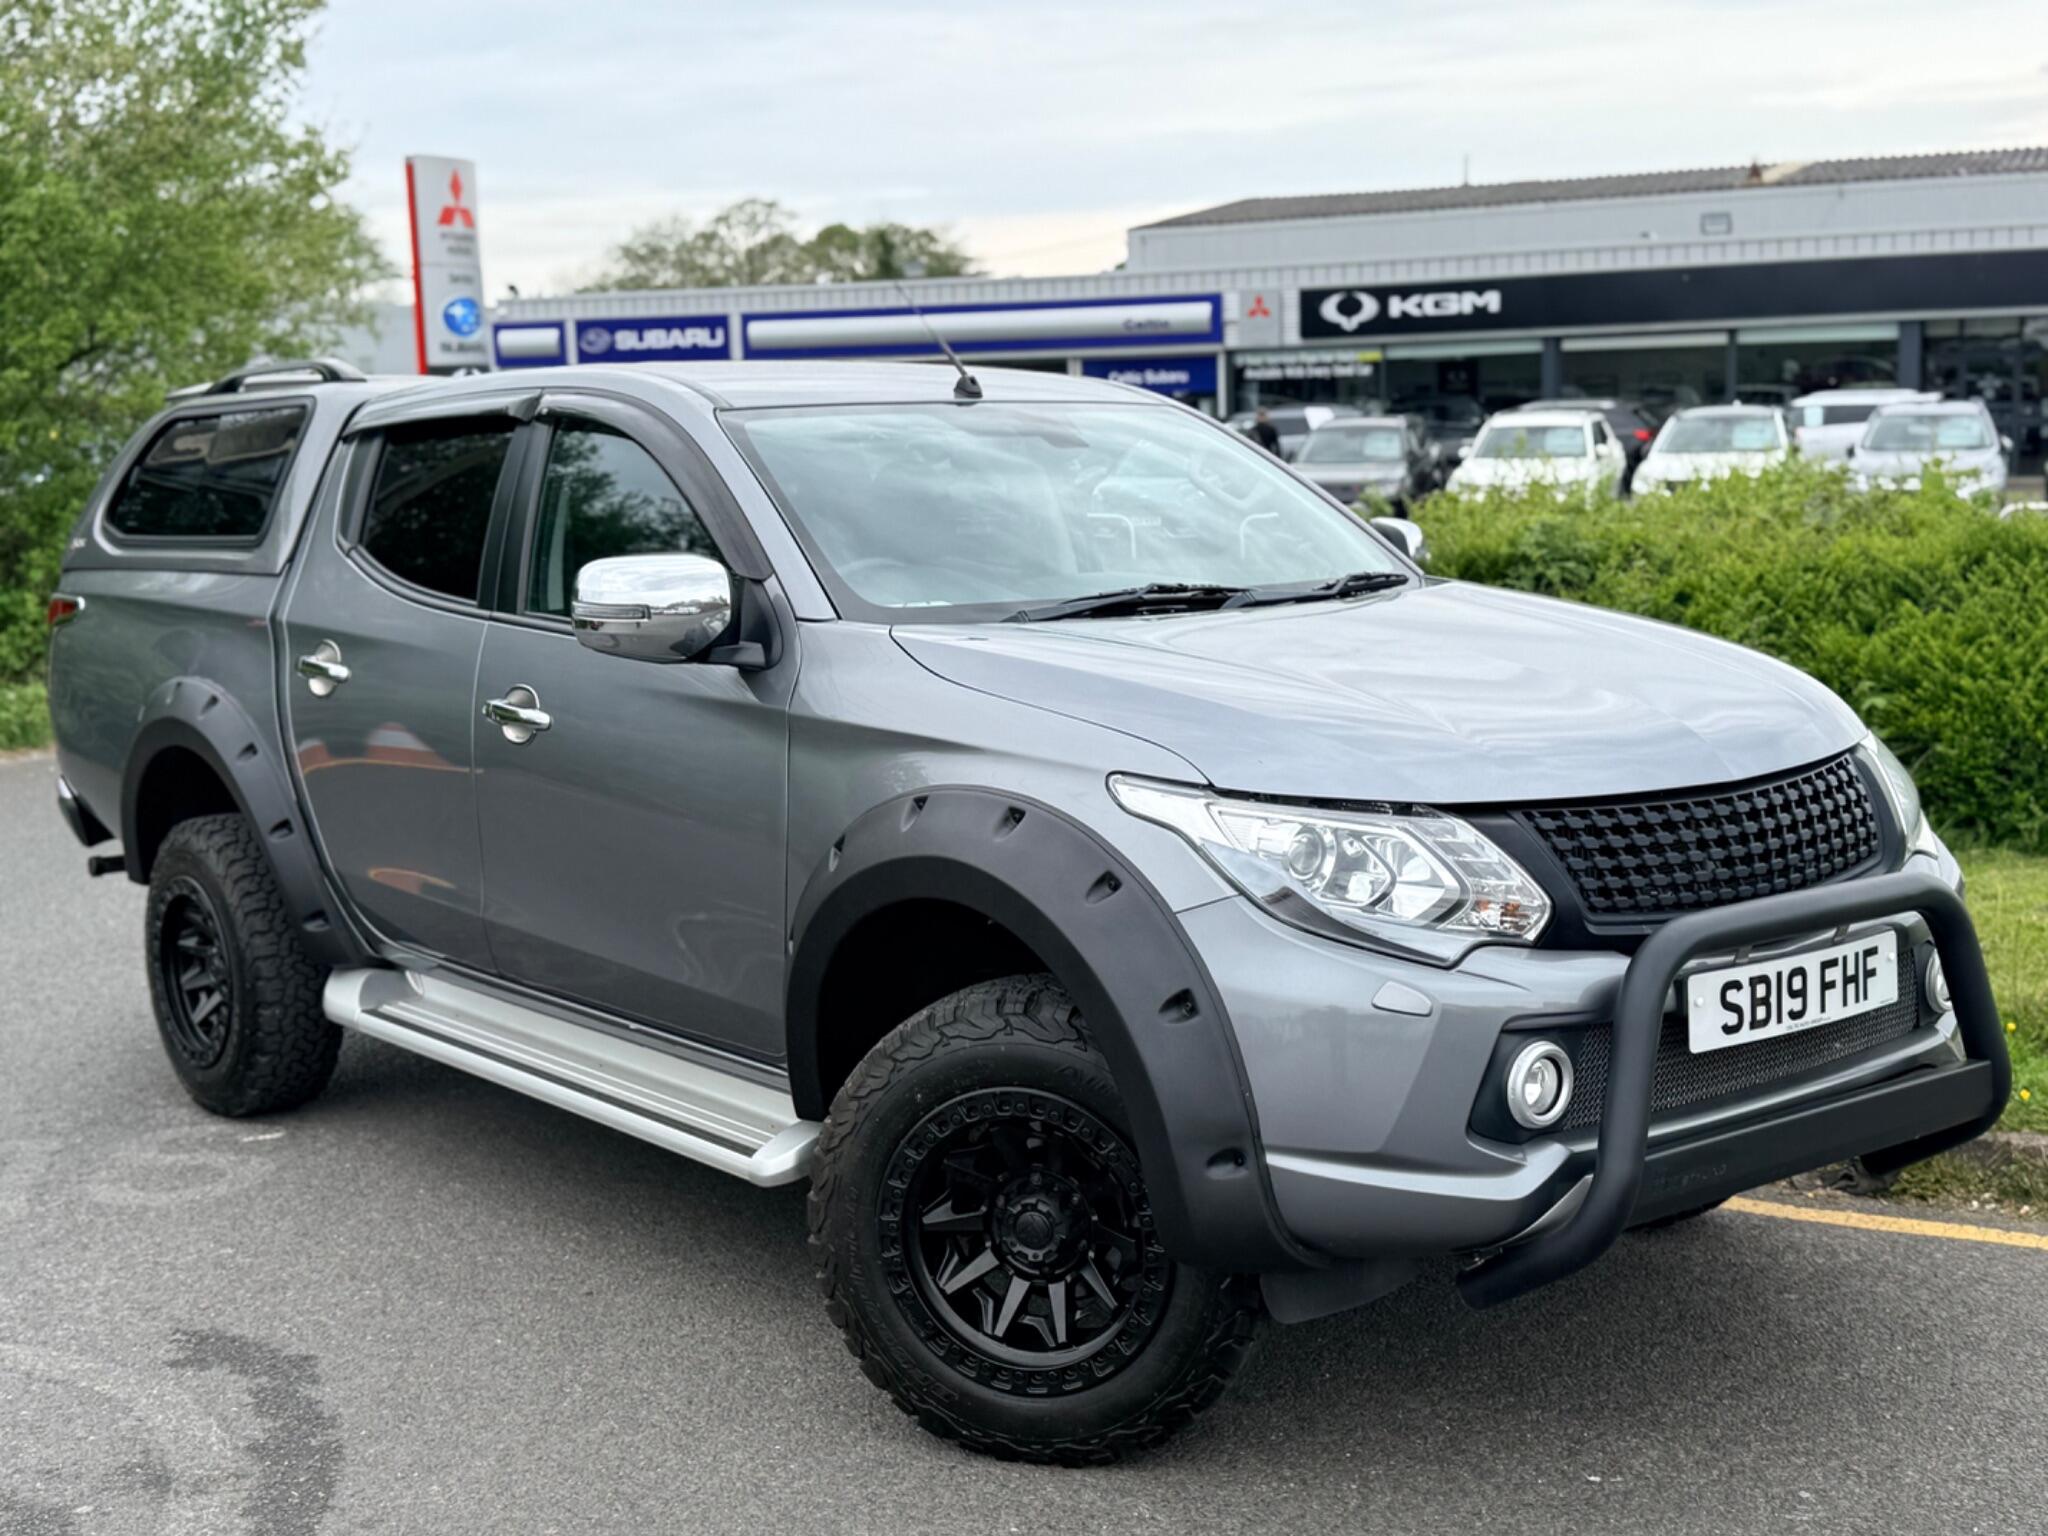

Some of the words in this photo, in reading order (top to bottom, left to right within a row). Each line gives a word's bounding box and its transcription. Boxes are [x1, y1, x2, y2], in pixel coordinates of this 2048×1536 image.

[1388, 290, 1501, 319] KGM
[614, 327, 725, 350] SUBARU
[1720, 966, 1808, 1035] SB19
[1820, 946, 1878, 1014] FHF
